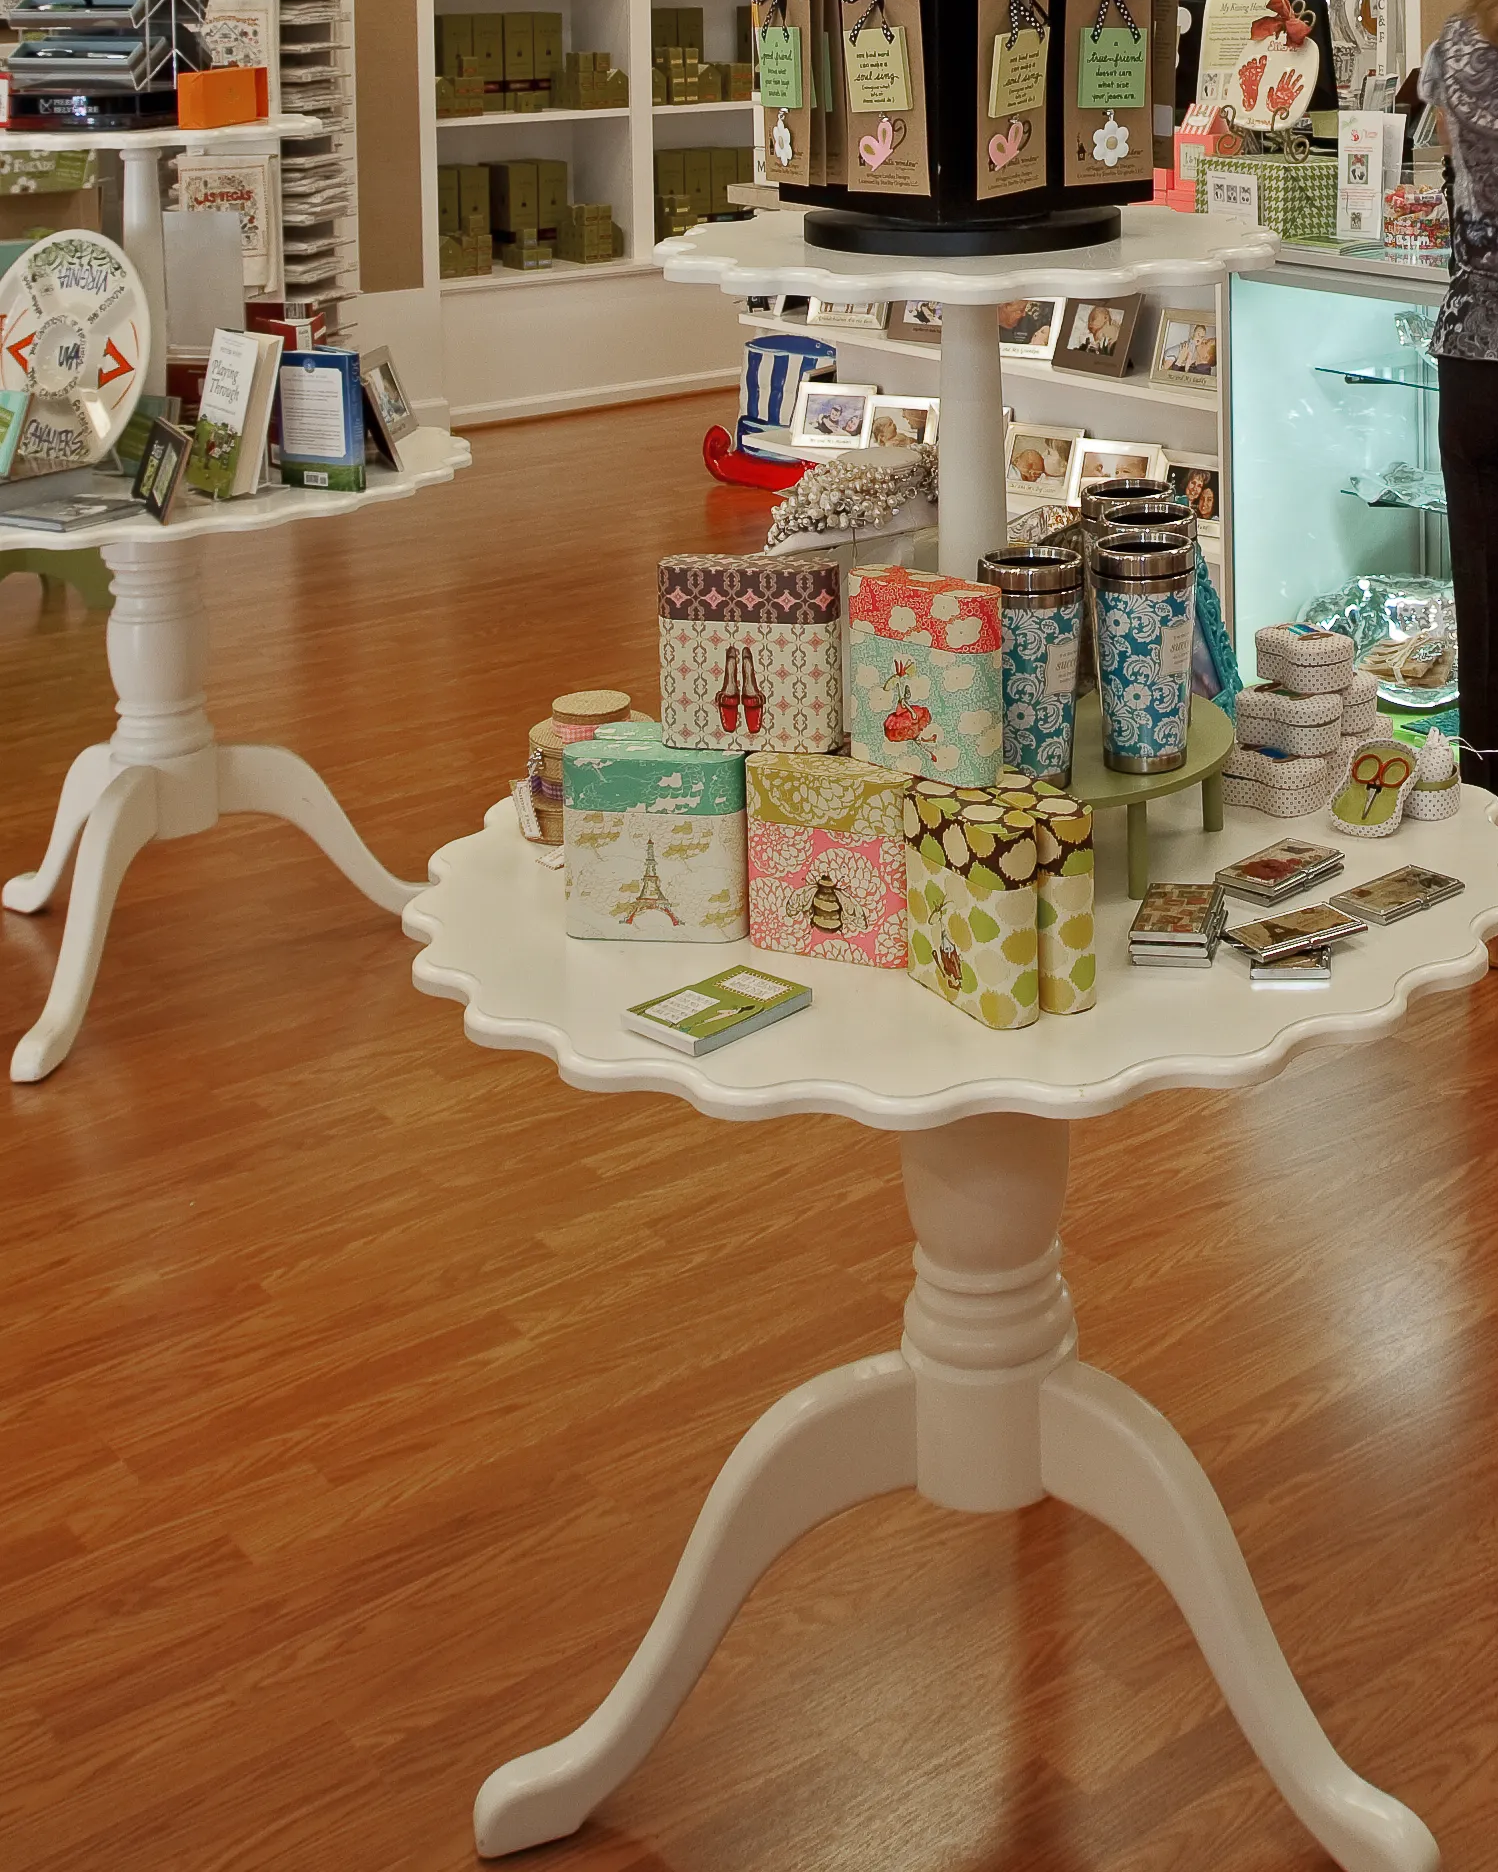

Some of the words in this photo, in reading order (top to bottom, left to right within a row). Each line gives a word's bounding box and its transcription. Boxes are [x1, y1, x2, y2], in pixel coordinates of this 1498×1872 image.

[1220, 3, 1230, 14] My
[1230, 3, 1249, 14] Kissing
[854, 71, 872, 82] soul
[874, 69, 900, 85] sing
[194, 193, 216, 205] LAS
[220, 190, 254, 203] VEGAS
[58, 265, 108, 295] VIRGINIA
[211, 360, 240, 385] Playing
[210, 378, 240, 404] Through
